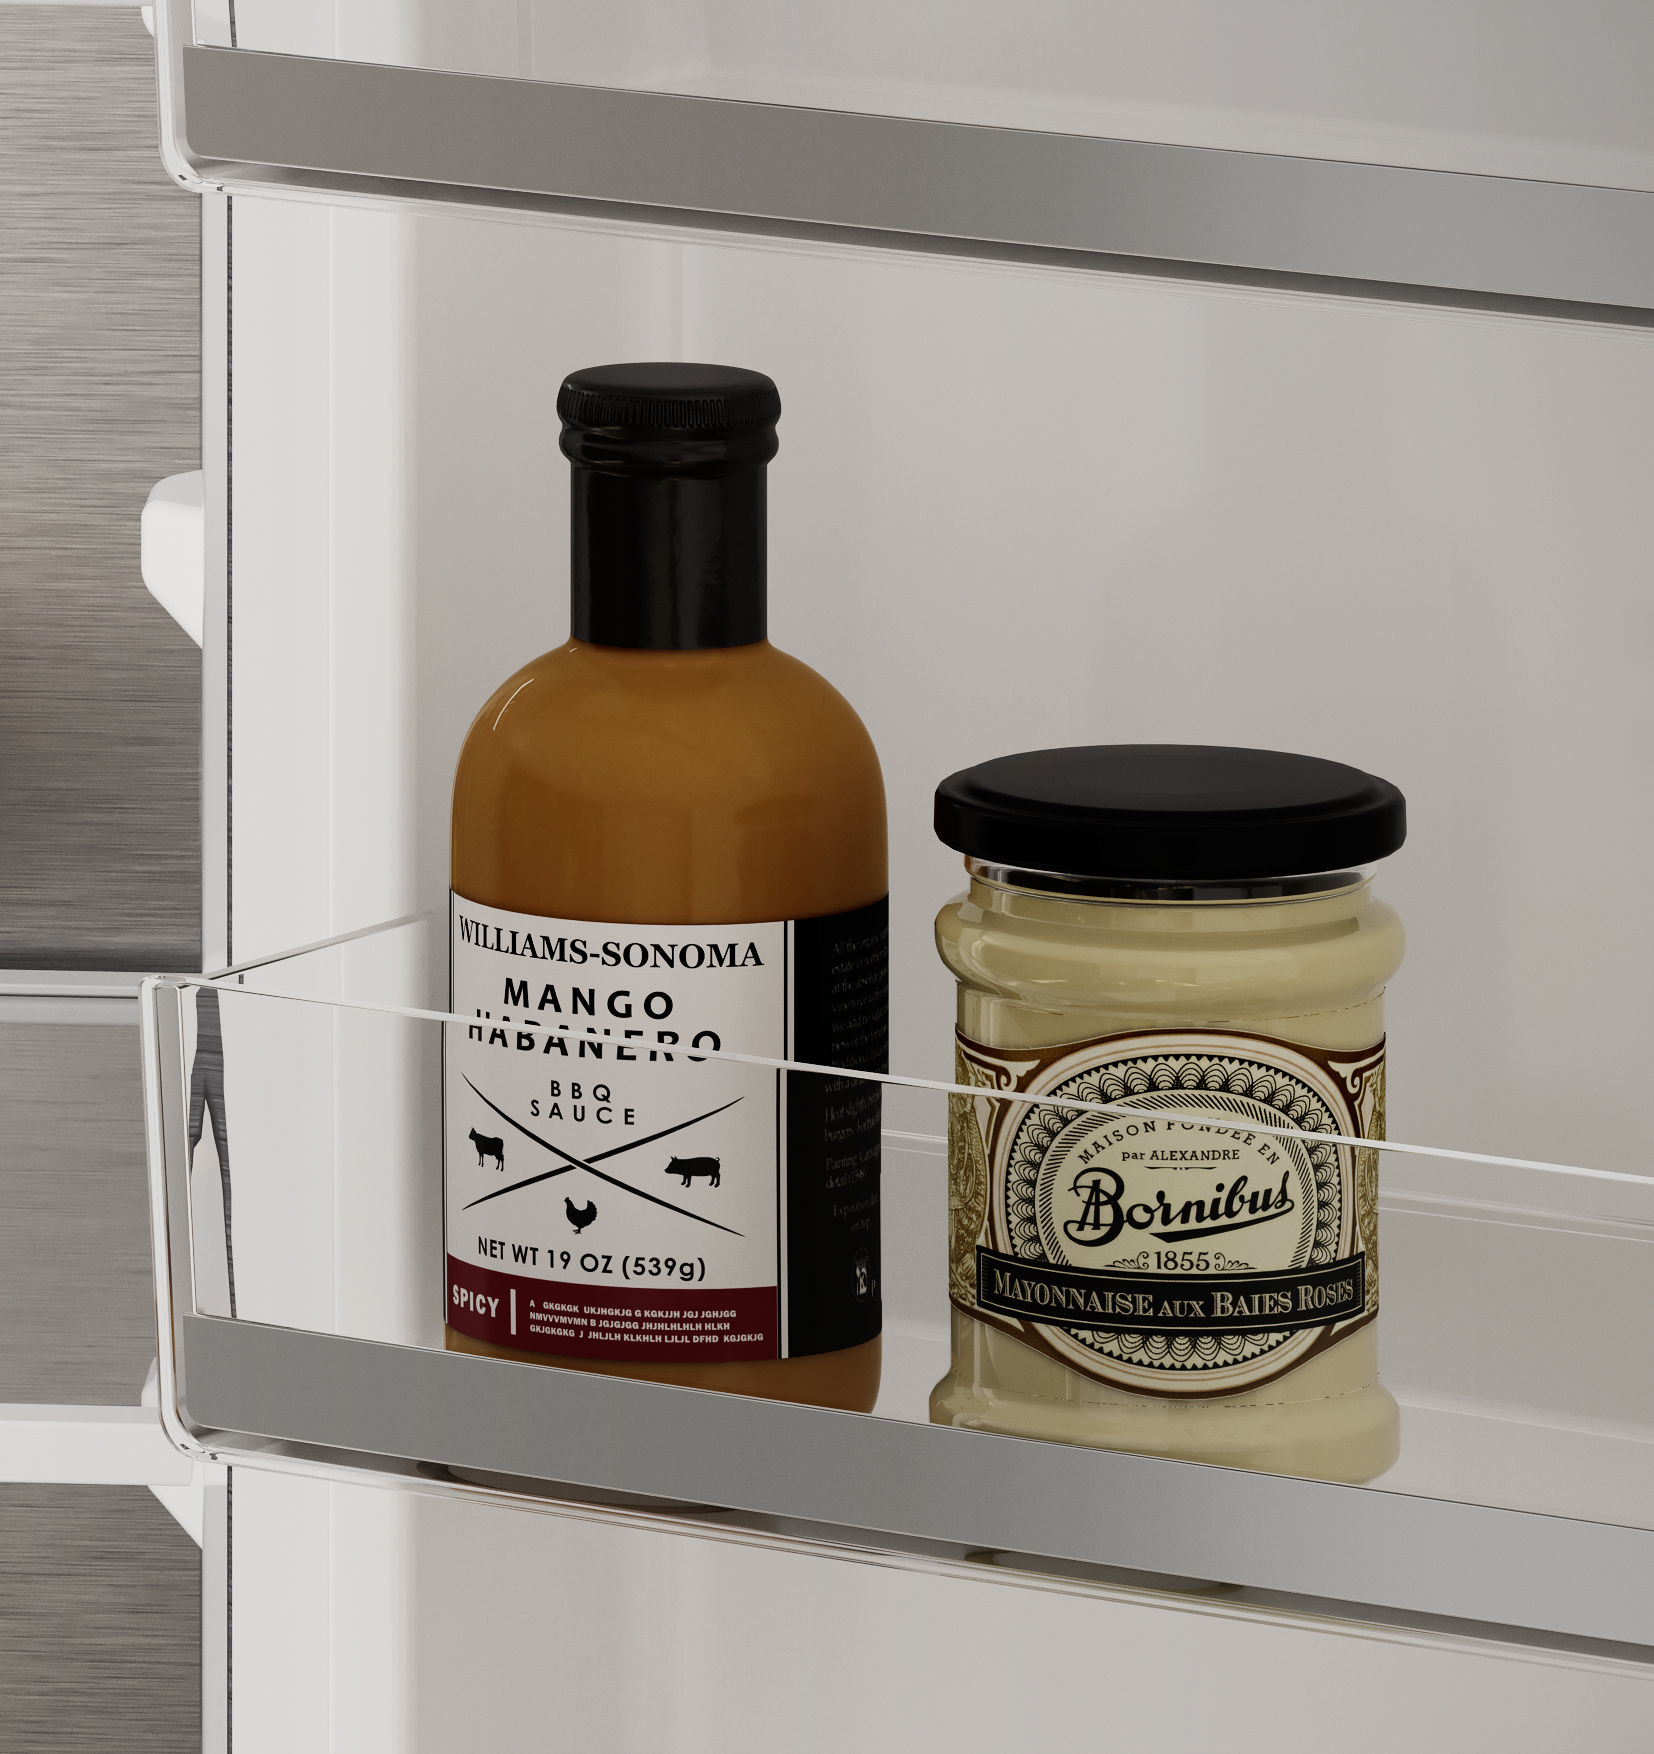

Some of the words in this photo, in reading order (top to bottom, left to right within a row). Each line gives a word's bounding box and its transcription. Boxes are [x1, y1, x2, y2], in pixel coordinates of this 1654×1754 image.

[459, 915, 765, 969] WILLIAMS-SONOMA
[502, 977, 674, 1020] MANGO
[469, 1009, 721, 1062] HABANERO
[551, 1080, 611, 1103] BBQ
[530, 1099, 634, 1125] SAUCE
[1077, 1120, 1157, 1164] MAISON
[1257, 1143, 1280, 1165] EN
[1122, 1152, 1145, 1161] par
[1149, 1149, 1240, 1161] ALEXANDRE
[478, 1236, 505, 1260] NET
[512, 1244, 539, 1266] WT
[547, 1249, 571, 1270] 19
[580, 1253, 613, 1274] OZ
[622, 1256, 705, 1282] (539g)
[1154, 1251, 1210, 1271] 1855
[453, 1284, 499, 1318] SPICY
[994, 1269, 1153, 1316] MAYONNAISE
[1158, 1300, 1205, 1317] AUX
[1211, 1291, 1292, 1317] BAIES
[1297, 1279, 1353, 1311] ROSES
[634, 1309, 641, 1317] G
[705, 1322, 730, 1330] HLKH
[579, 1330, 583, 1338] J
[693, 1335, 719, 1343] DFHD
